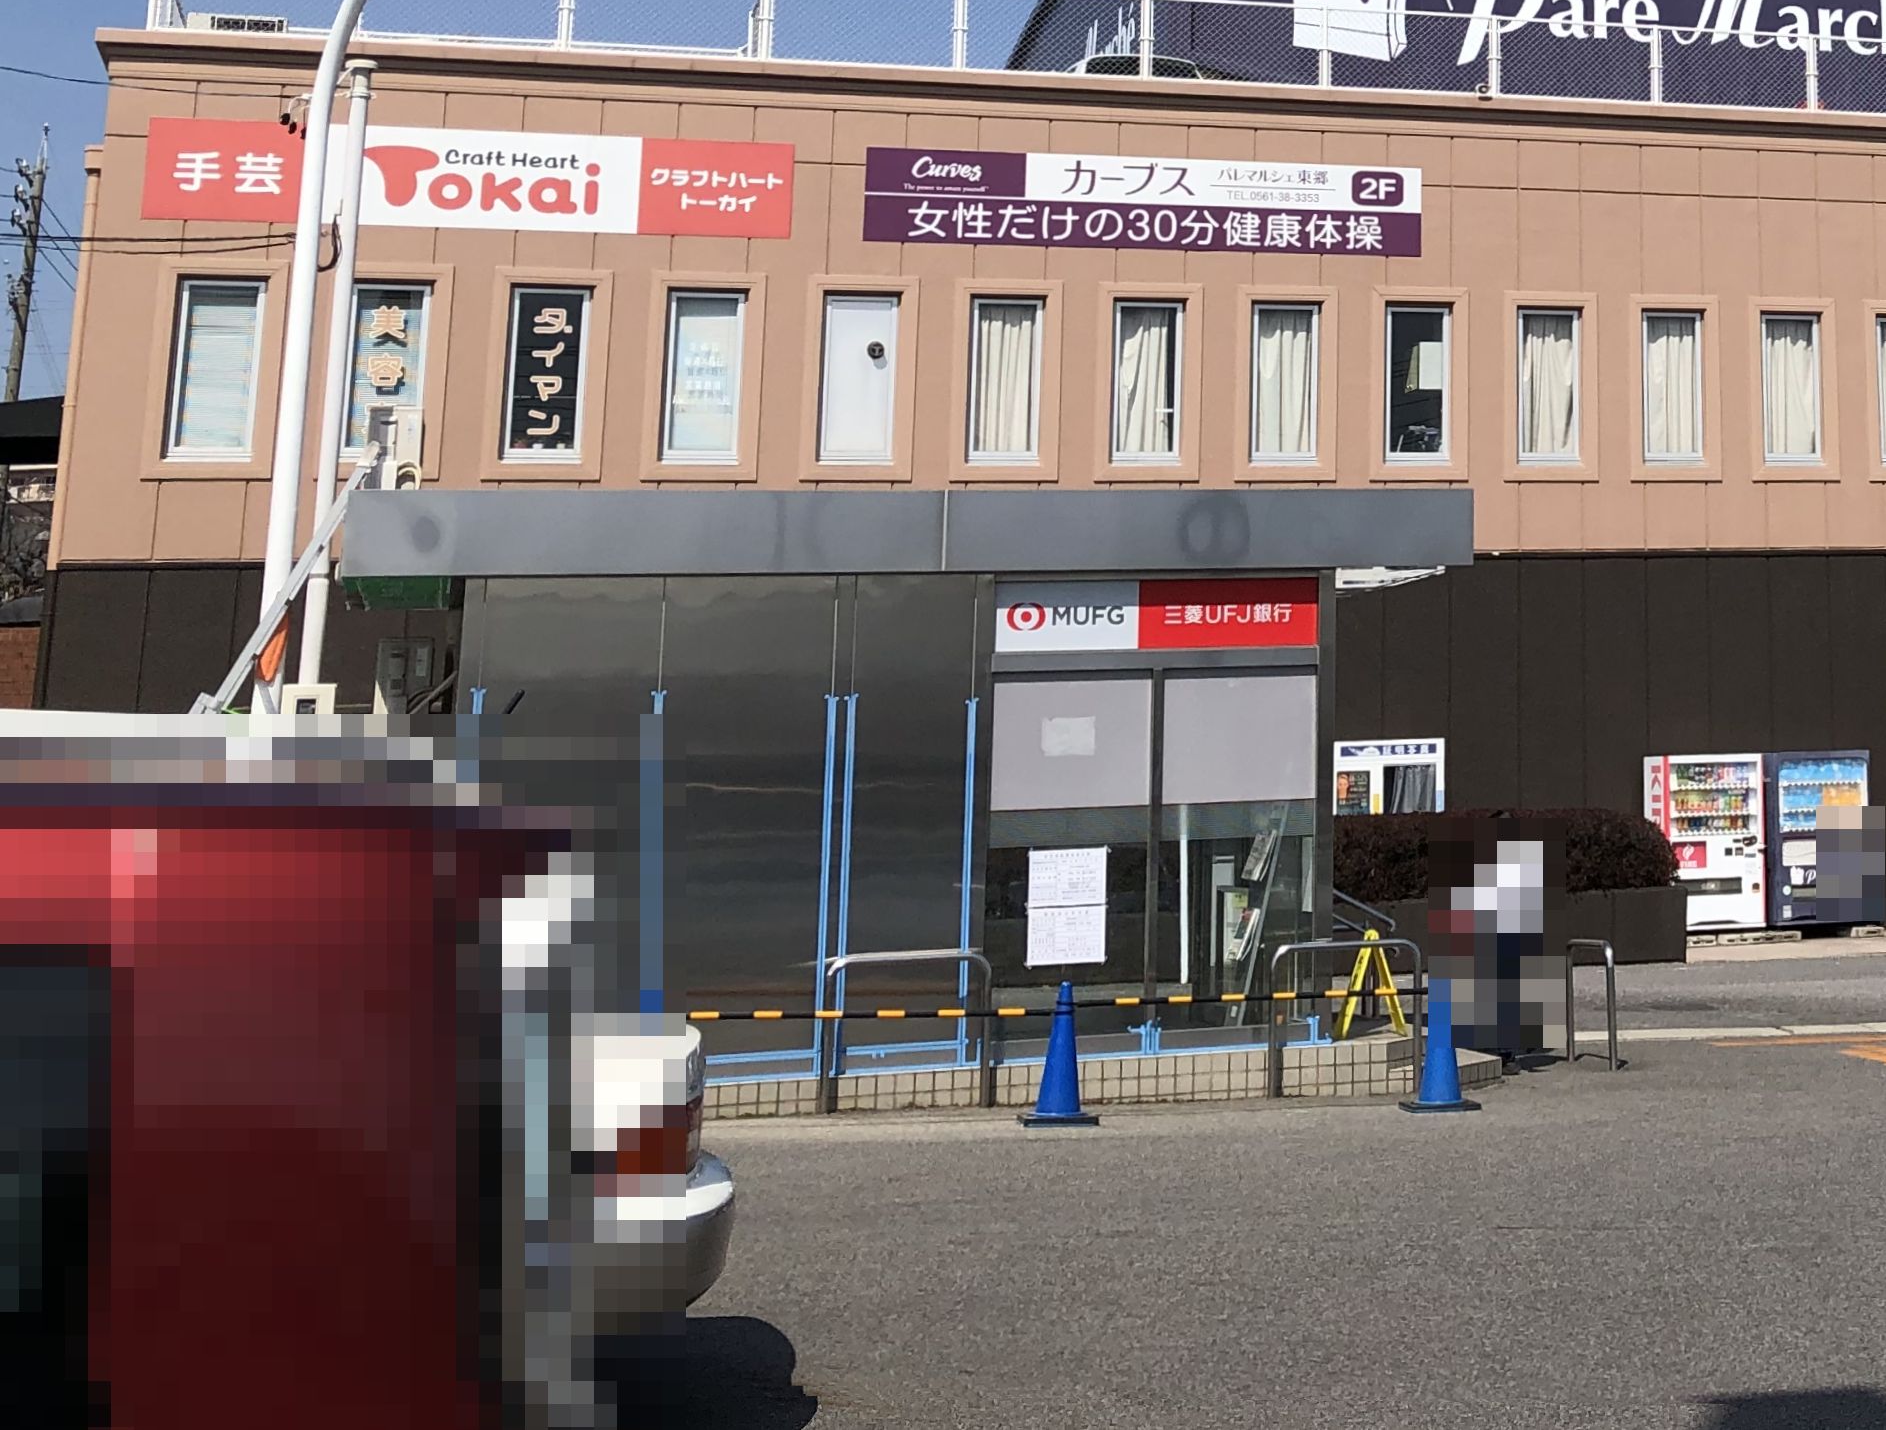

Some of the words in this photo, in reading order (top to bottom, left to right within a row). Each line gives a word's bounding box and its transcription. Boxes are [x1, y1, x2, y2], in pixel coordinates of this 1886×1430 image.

[445, 149, 505, 168] Craft
[511, 153, 580, 171] Heart
[911, 156, 982, 182] Curves
[172, 151, 284, 195] 手芸
[650, 167, 784, 190] クラフトハート
[1062, 160, 1196, 197] カーブス
[1217, 167, 1329, 186] パレマルシェ東郷
[1358, 177, 1397, 201] 2F
[680, 192, 757, 214] トーカイ
[907, 200, 1383, 251] 女性だけの30分健康体操
[361, 305, 406, 410] 美容
[1052, 605, 1125, 626] MUFG
[1163, 603, 1293, 626] 三菱UFJ銀行
